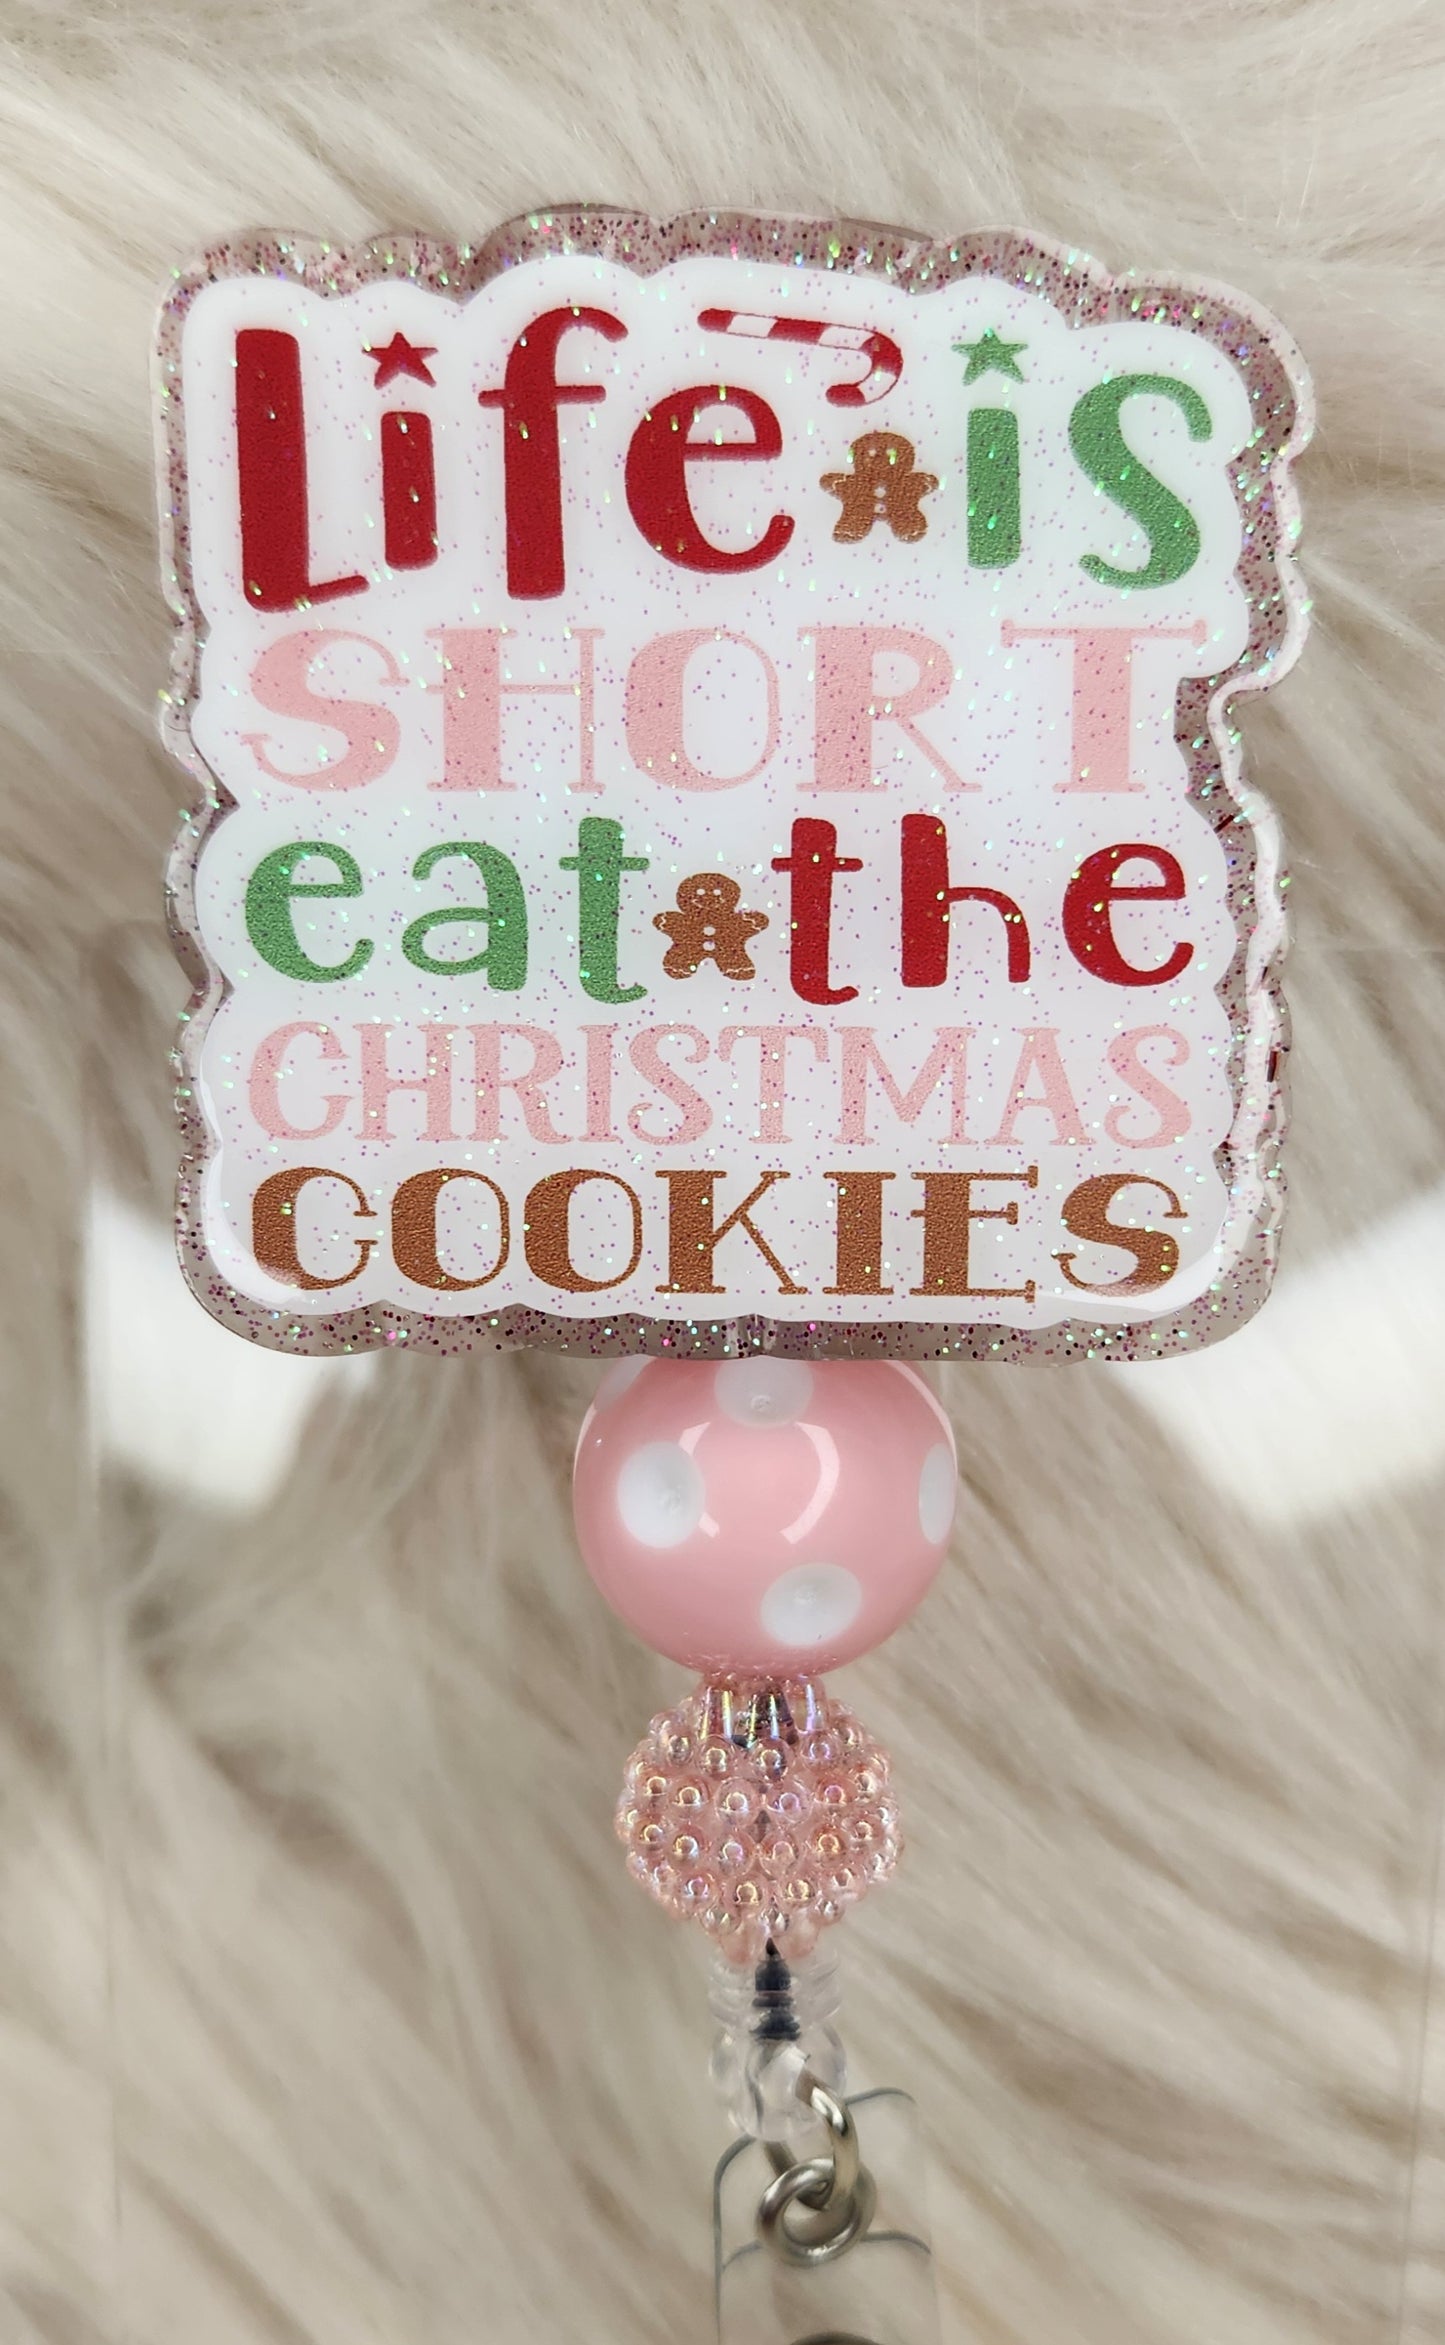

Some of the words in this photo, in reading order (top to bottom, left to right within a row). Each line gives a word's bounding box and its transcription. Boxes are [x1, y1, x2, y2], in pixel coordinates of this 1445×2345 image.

[234, 306, 795, 610] Life
[953, 328, 1213, 586] is
[243, 621, 1209, 794] SHORT
[245, 816, 651, 1004] eat
[773, 815, 1194, 1006] the
[248, 1021, 1192, 1147] CHRISTMAS
[250, 1165, 1188, 1302] COOKIES
